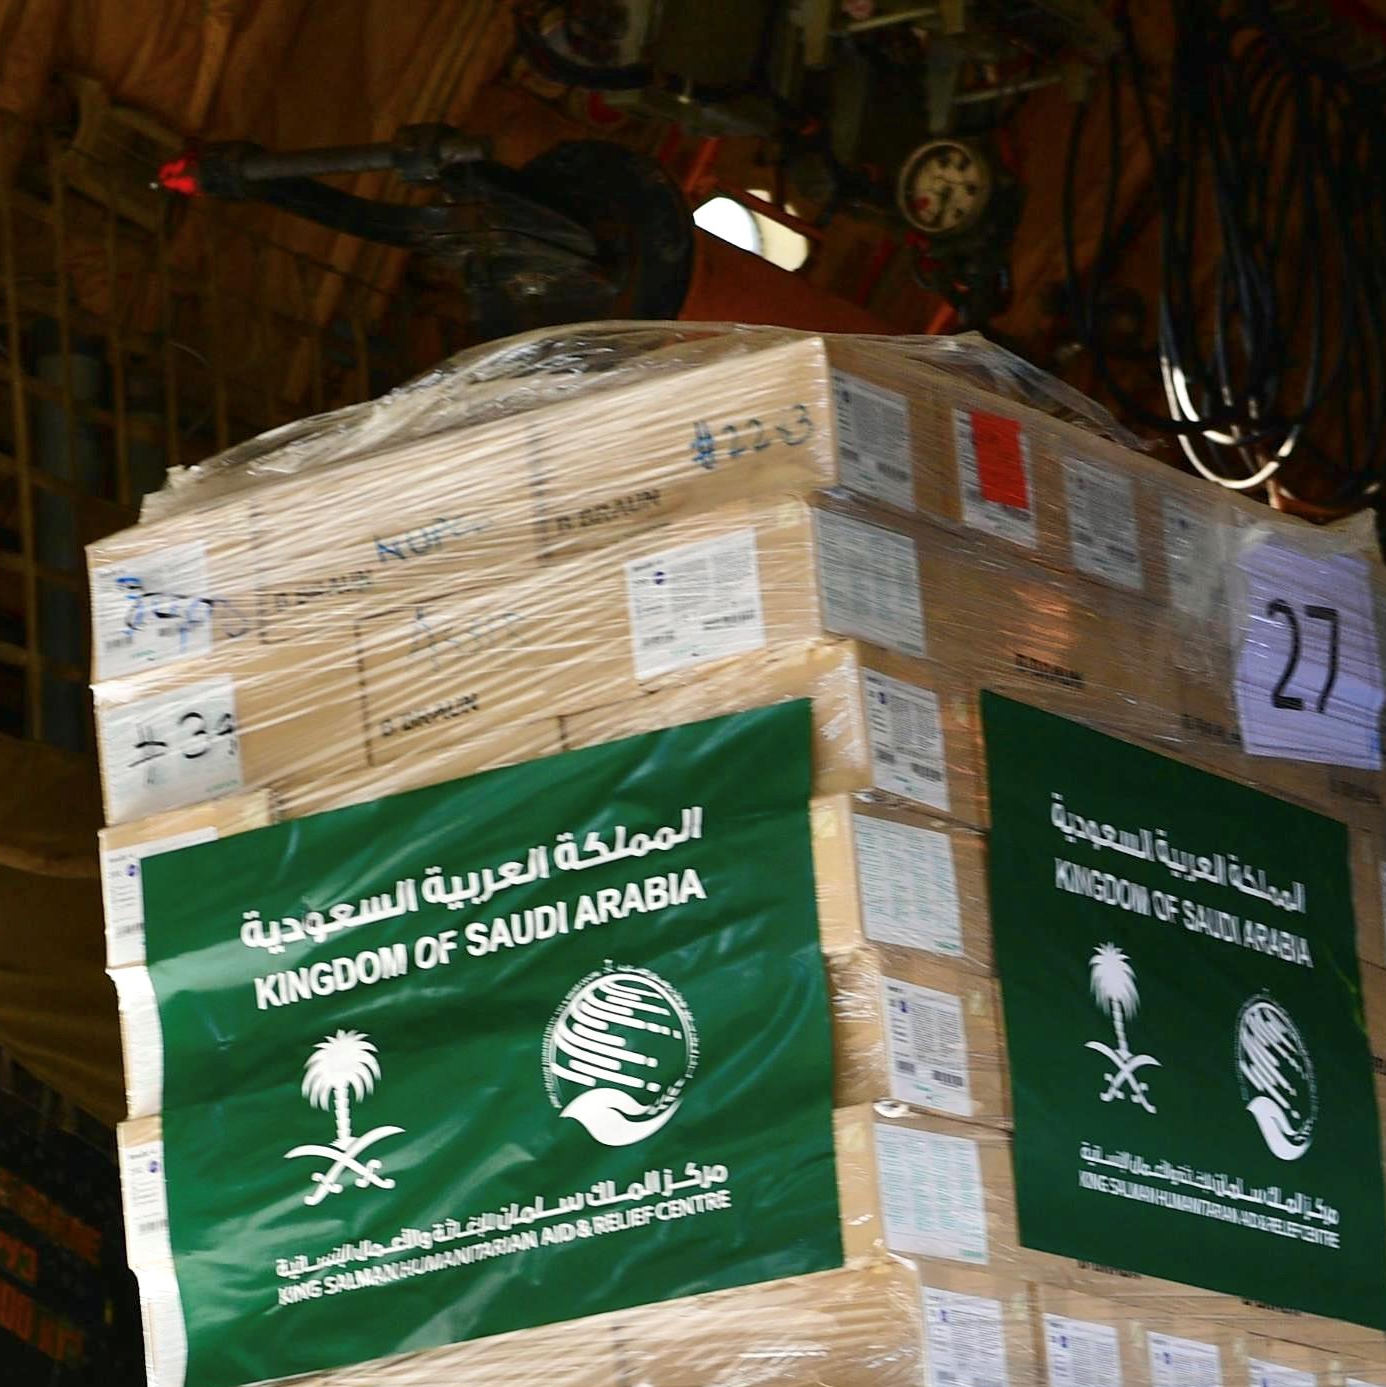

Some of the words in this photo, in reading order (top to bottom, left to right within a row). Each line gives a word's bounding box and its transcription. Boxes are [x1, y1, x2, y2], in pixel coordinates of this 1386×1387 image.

[1267, 599, 1340, 715] 27
[553, 806, 703, 871] المملكة
[1051, 791, 1155, 862] السعودية
[1155, 828, 1228, 886] العربية
[421, 845, 550, 911] العربية
[1227, 854, 1307, 914] المملكة
[240, 878, 416, 955] السعودية
[253, 943, 408, 1011] KINGDOM
[414, 929, 458, 970] OF
[464, 901, 569, 957] SAUDI
[574, 868, 708, 931] ARABIA
[1054, 857, 1151, 917] KINGDOM
[1152, 889, 1179, 924] OF
[1182, 899, 1243, 946] SAUDI
[1243, 920, 1314, 968] ARABIA
[585, 1169, 661, 1207] الملك
[661, 1161, 729, 1197] مركز
[496, 1195, 585, 1231] سلمان
[277, 1278, 324, 1306] KING
[324, 1263, 400, 1295] SALMAN
[400, 1230, 539, 1280] HUMANITARIAN
[540, 1222, 577, 1247] AID
[576, 1218, 595, 1239] &
[592, 1205, 656, 1236] RELIEF
[655, 1188, 733, 1221] CENTRE
